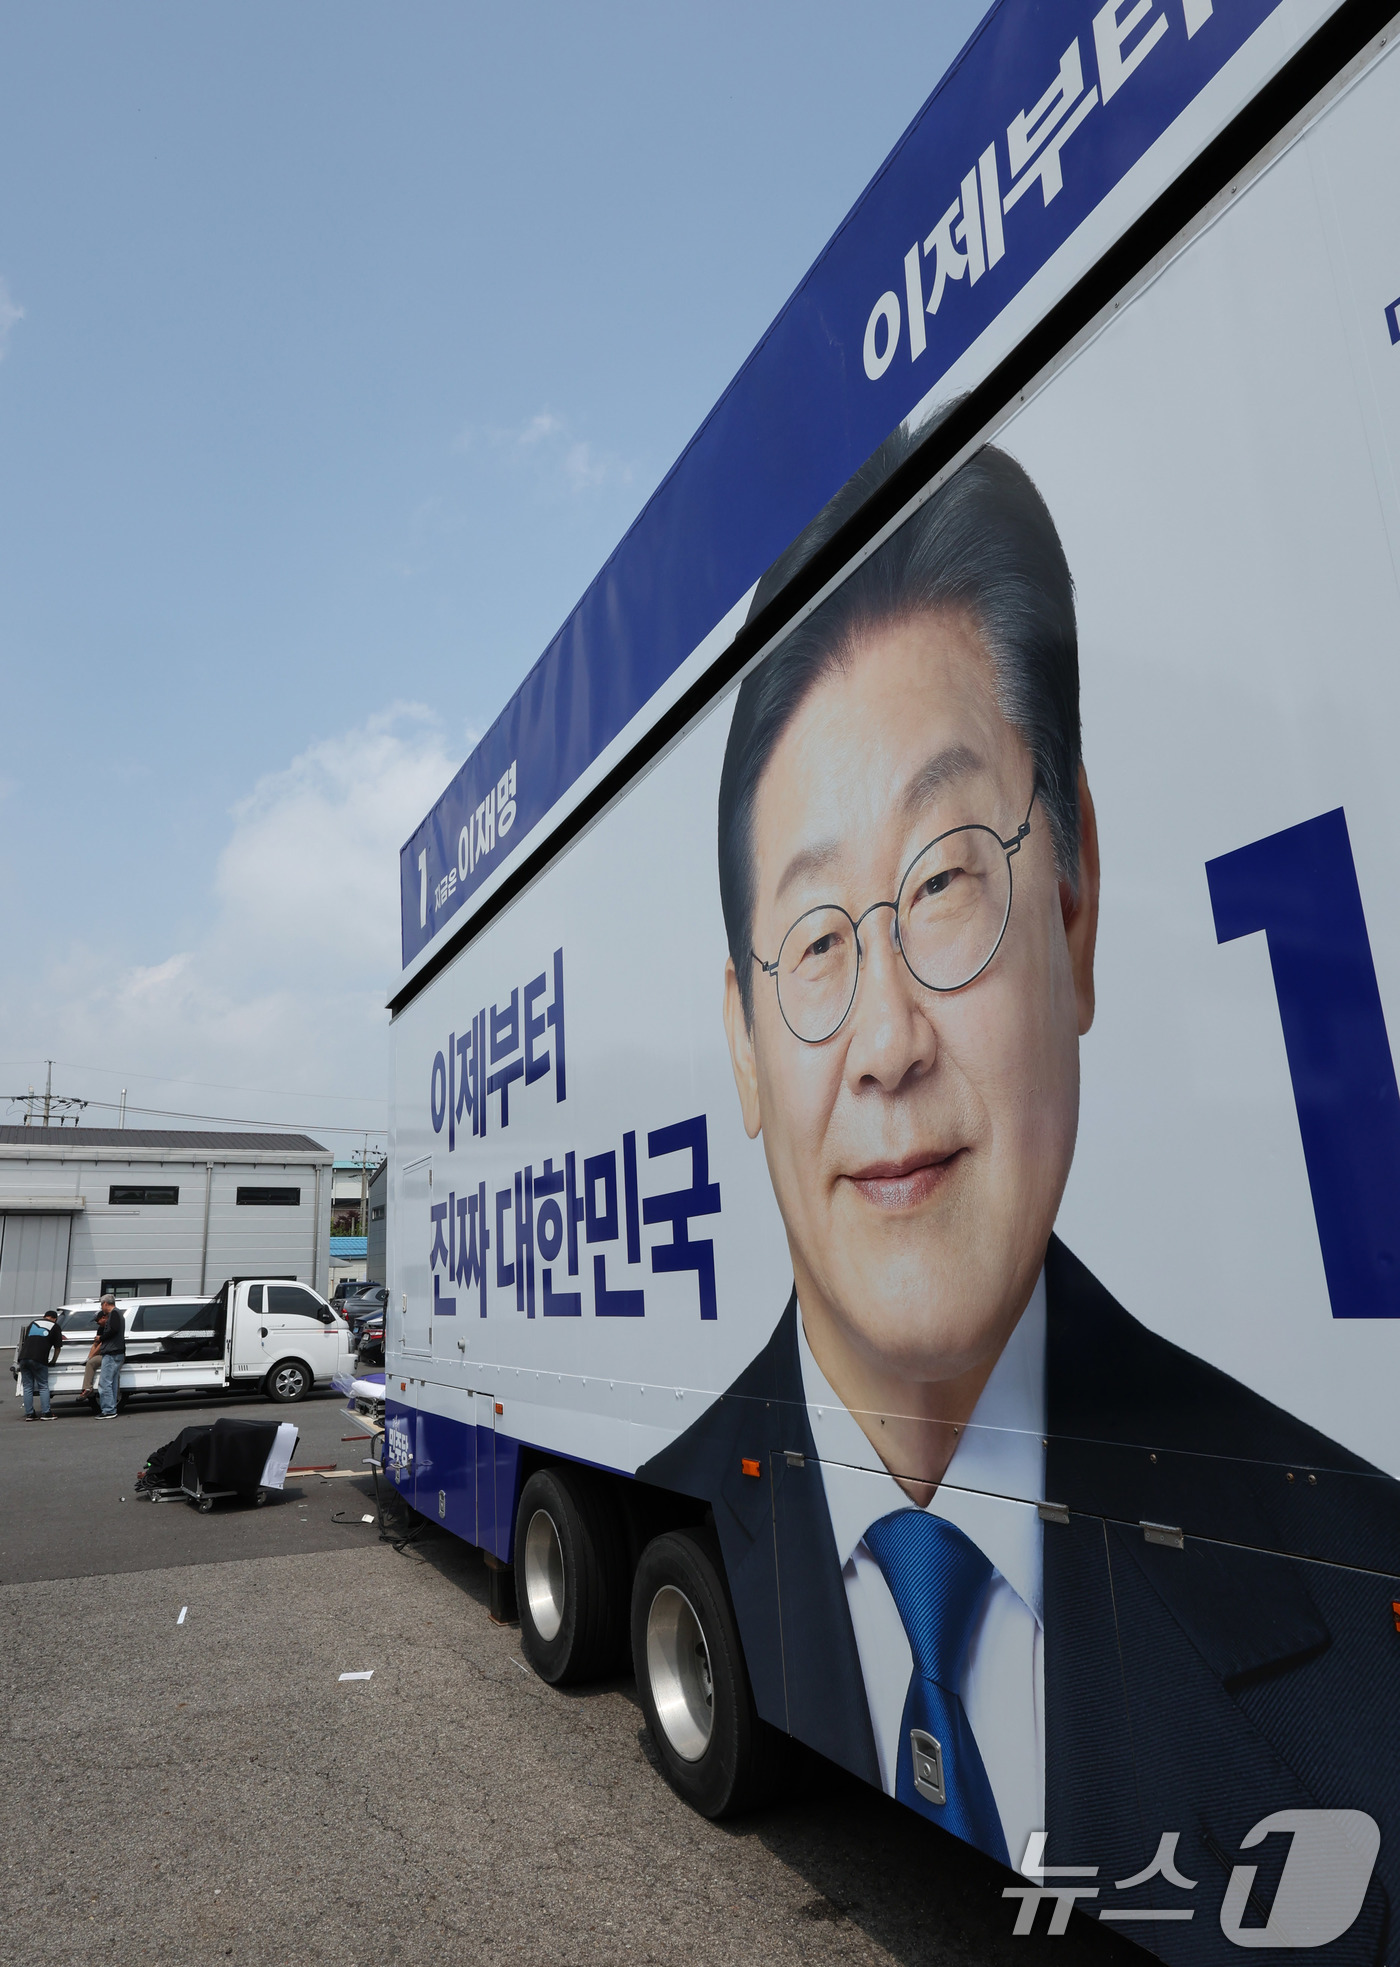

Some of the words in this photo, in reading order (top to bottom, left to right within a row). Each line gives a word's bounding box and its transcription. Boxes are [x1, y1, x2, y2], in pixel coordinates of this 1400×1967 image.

[418, 848, 428, 929] 1
[434, 867, 457, 913] 지금은
[458, 759, 518, 881] 이재명
[431, 947, 567, 1152] 이제부터
[1205, 806, 1400, 1319] 1
[430, 1181, 491, 1319] 진짜
[496, 1114, 722, 1321] 대한민국
